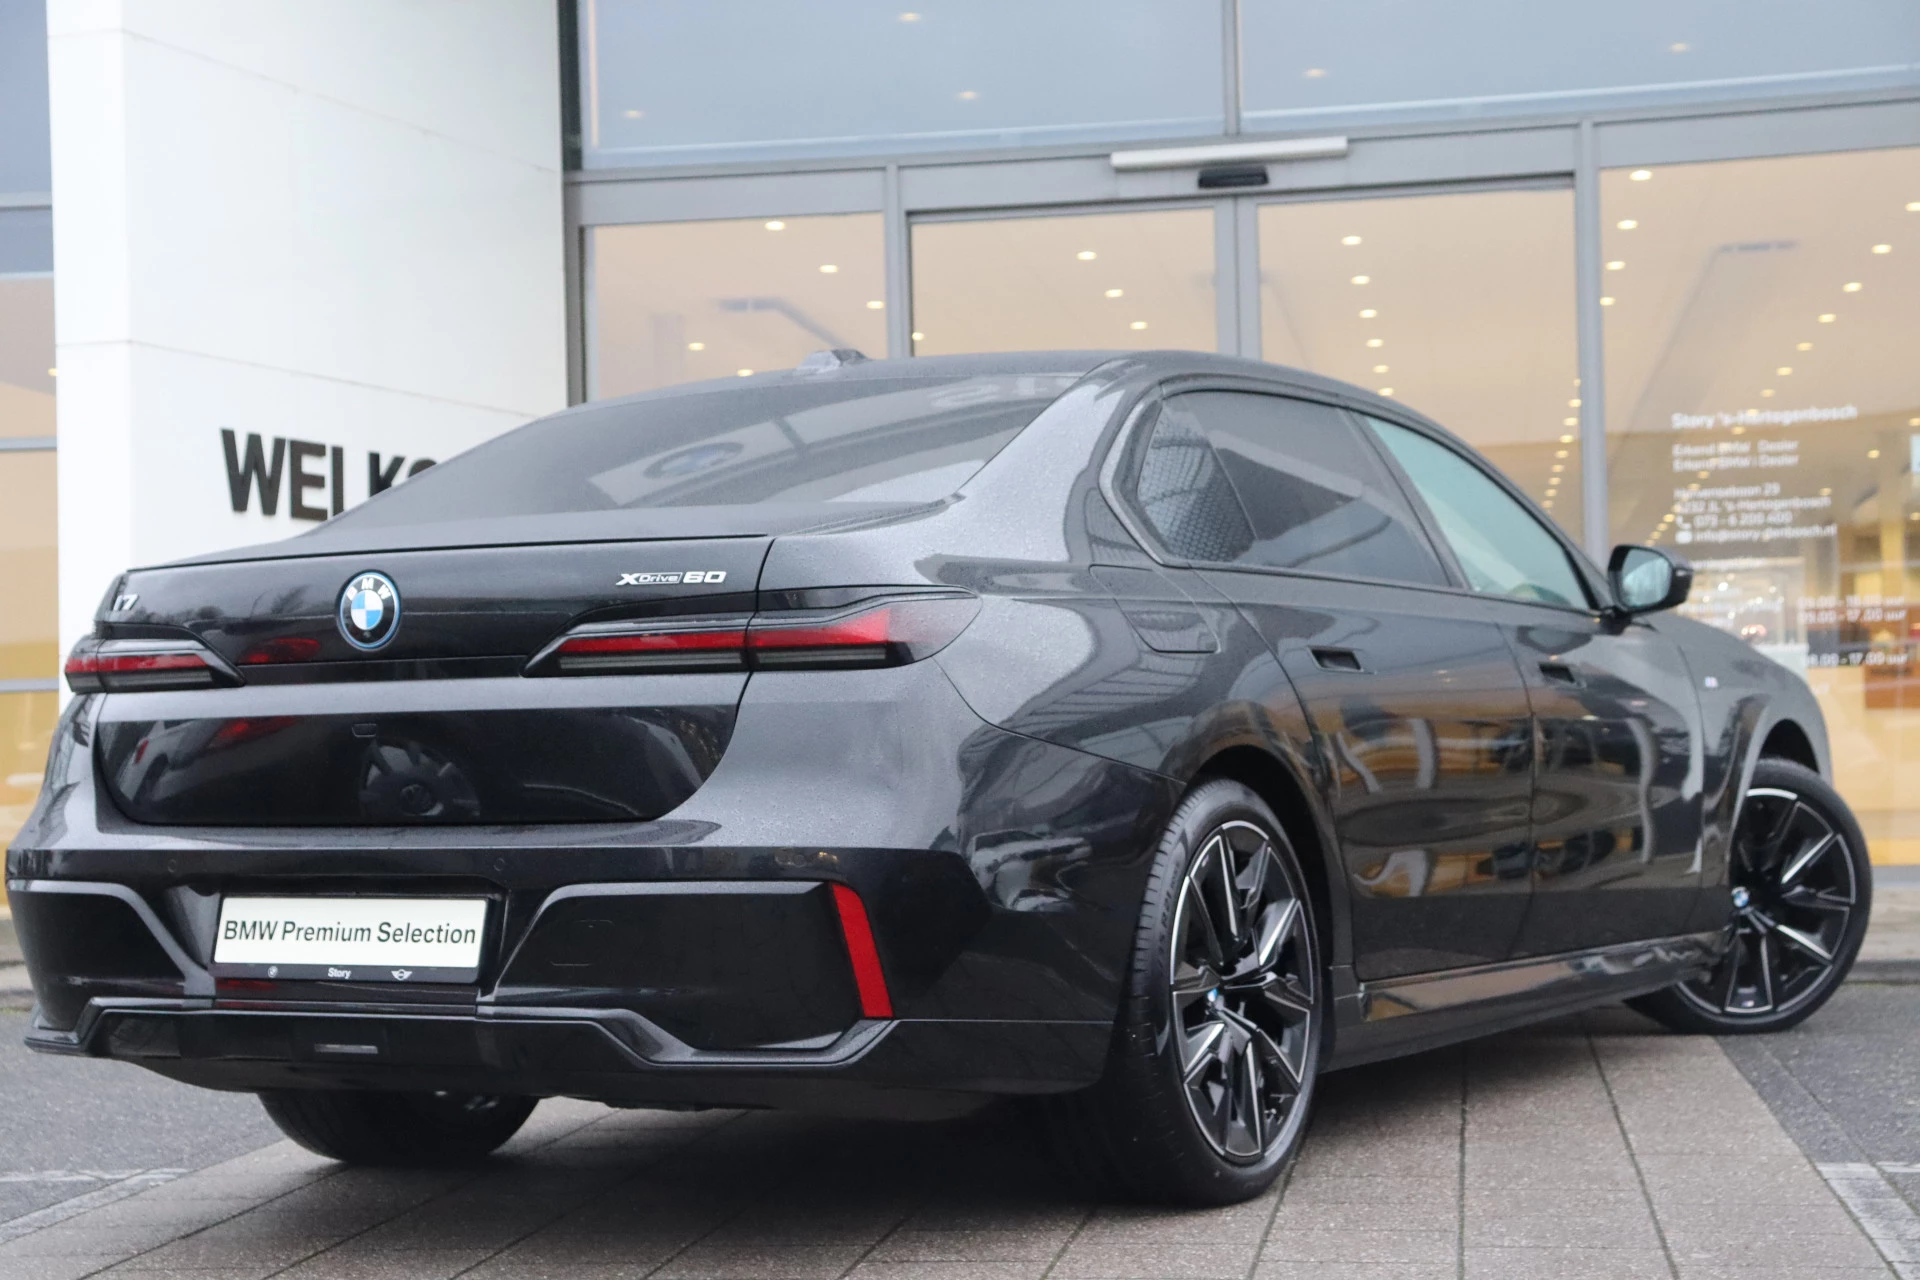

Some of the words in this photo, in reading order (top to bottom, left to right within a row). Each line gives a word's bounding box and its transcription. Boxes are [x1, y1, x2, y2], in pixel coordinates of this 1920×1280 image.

[1671, 412, 1715, 430] Story
[221, 429, 437, 521] WELK
[346, 577, 392, 600] BMW
[224, 920, 278, 940] BMW
[281, 921, 371, 943] Premium
[376, 922, 476, 944] Selection
[328, 967, 351, 980] Story
